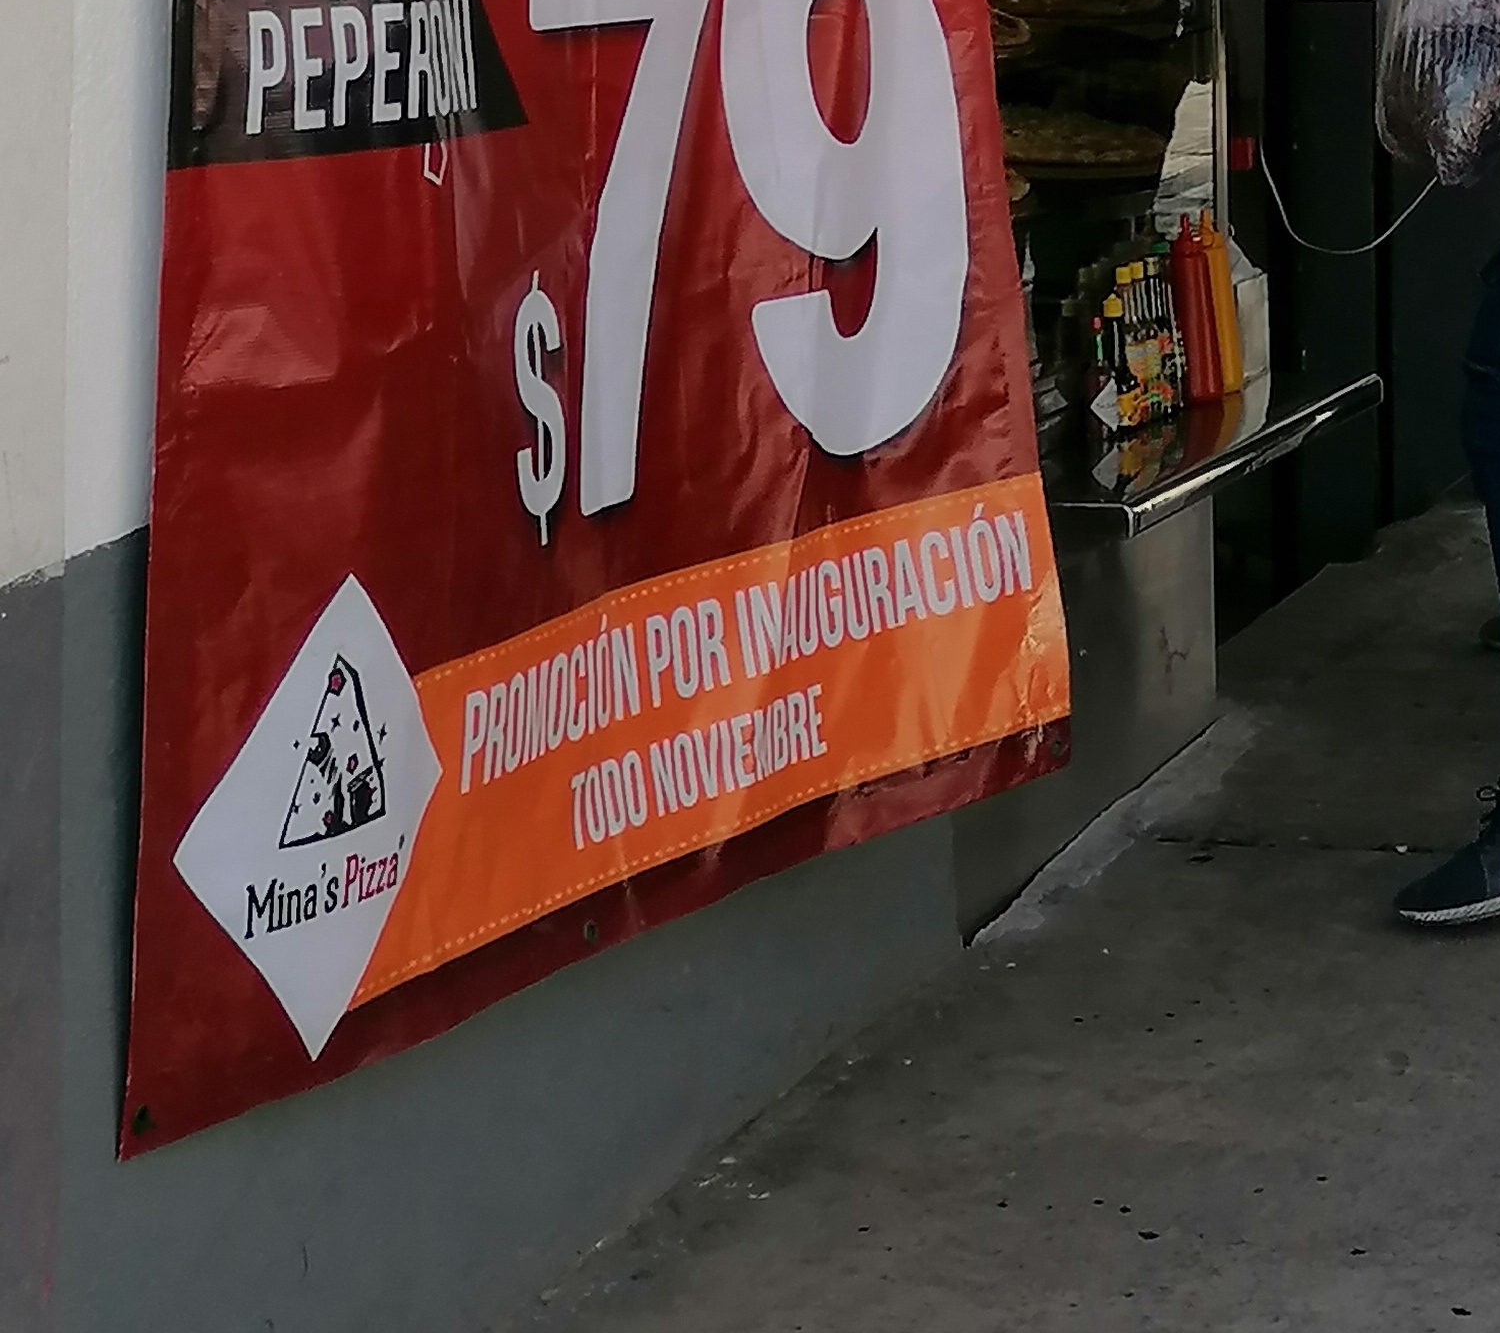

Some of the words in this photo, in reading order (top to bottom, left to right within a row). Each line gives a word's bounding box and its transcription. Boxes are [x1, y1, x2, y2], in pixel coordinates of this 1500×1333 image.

[459, 613, 640, 795] PROMOCIÓN
[646, 597, 731, 709] POR
[733, 503, 1033, 680] INAUGURACIÓN
[570, 750, 648, 851] TODO
[649, 683, 828, 818] NOVIEMBRE
[244, 862, 340, 940] Mina's
